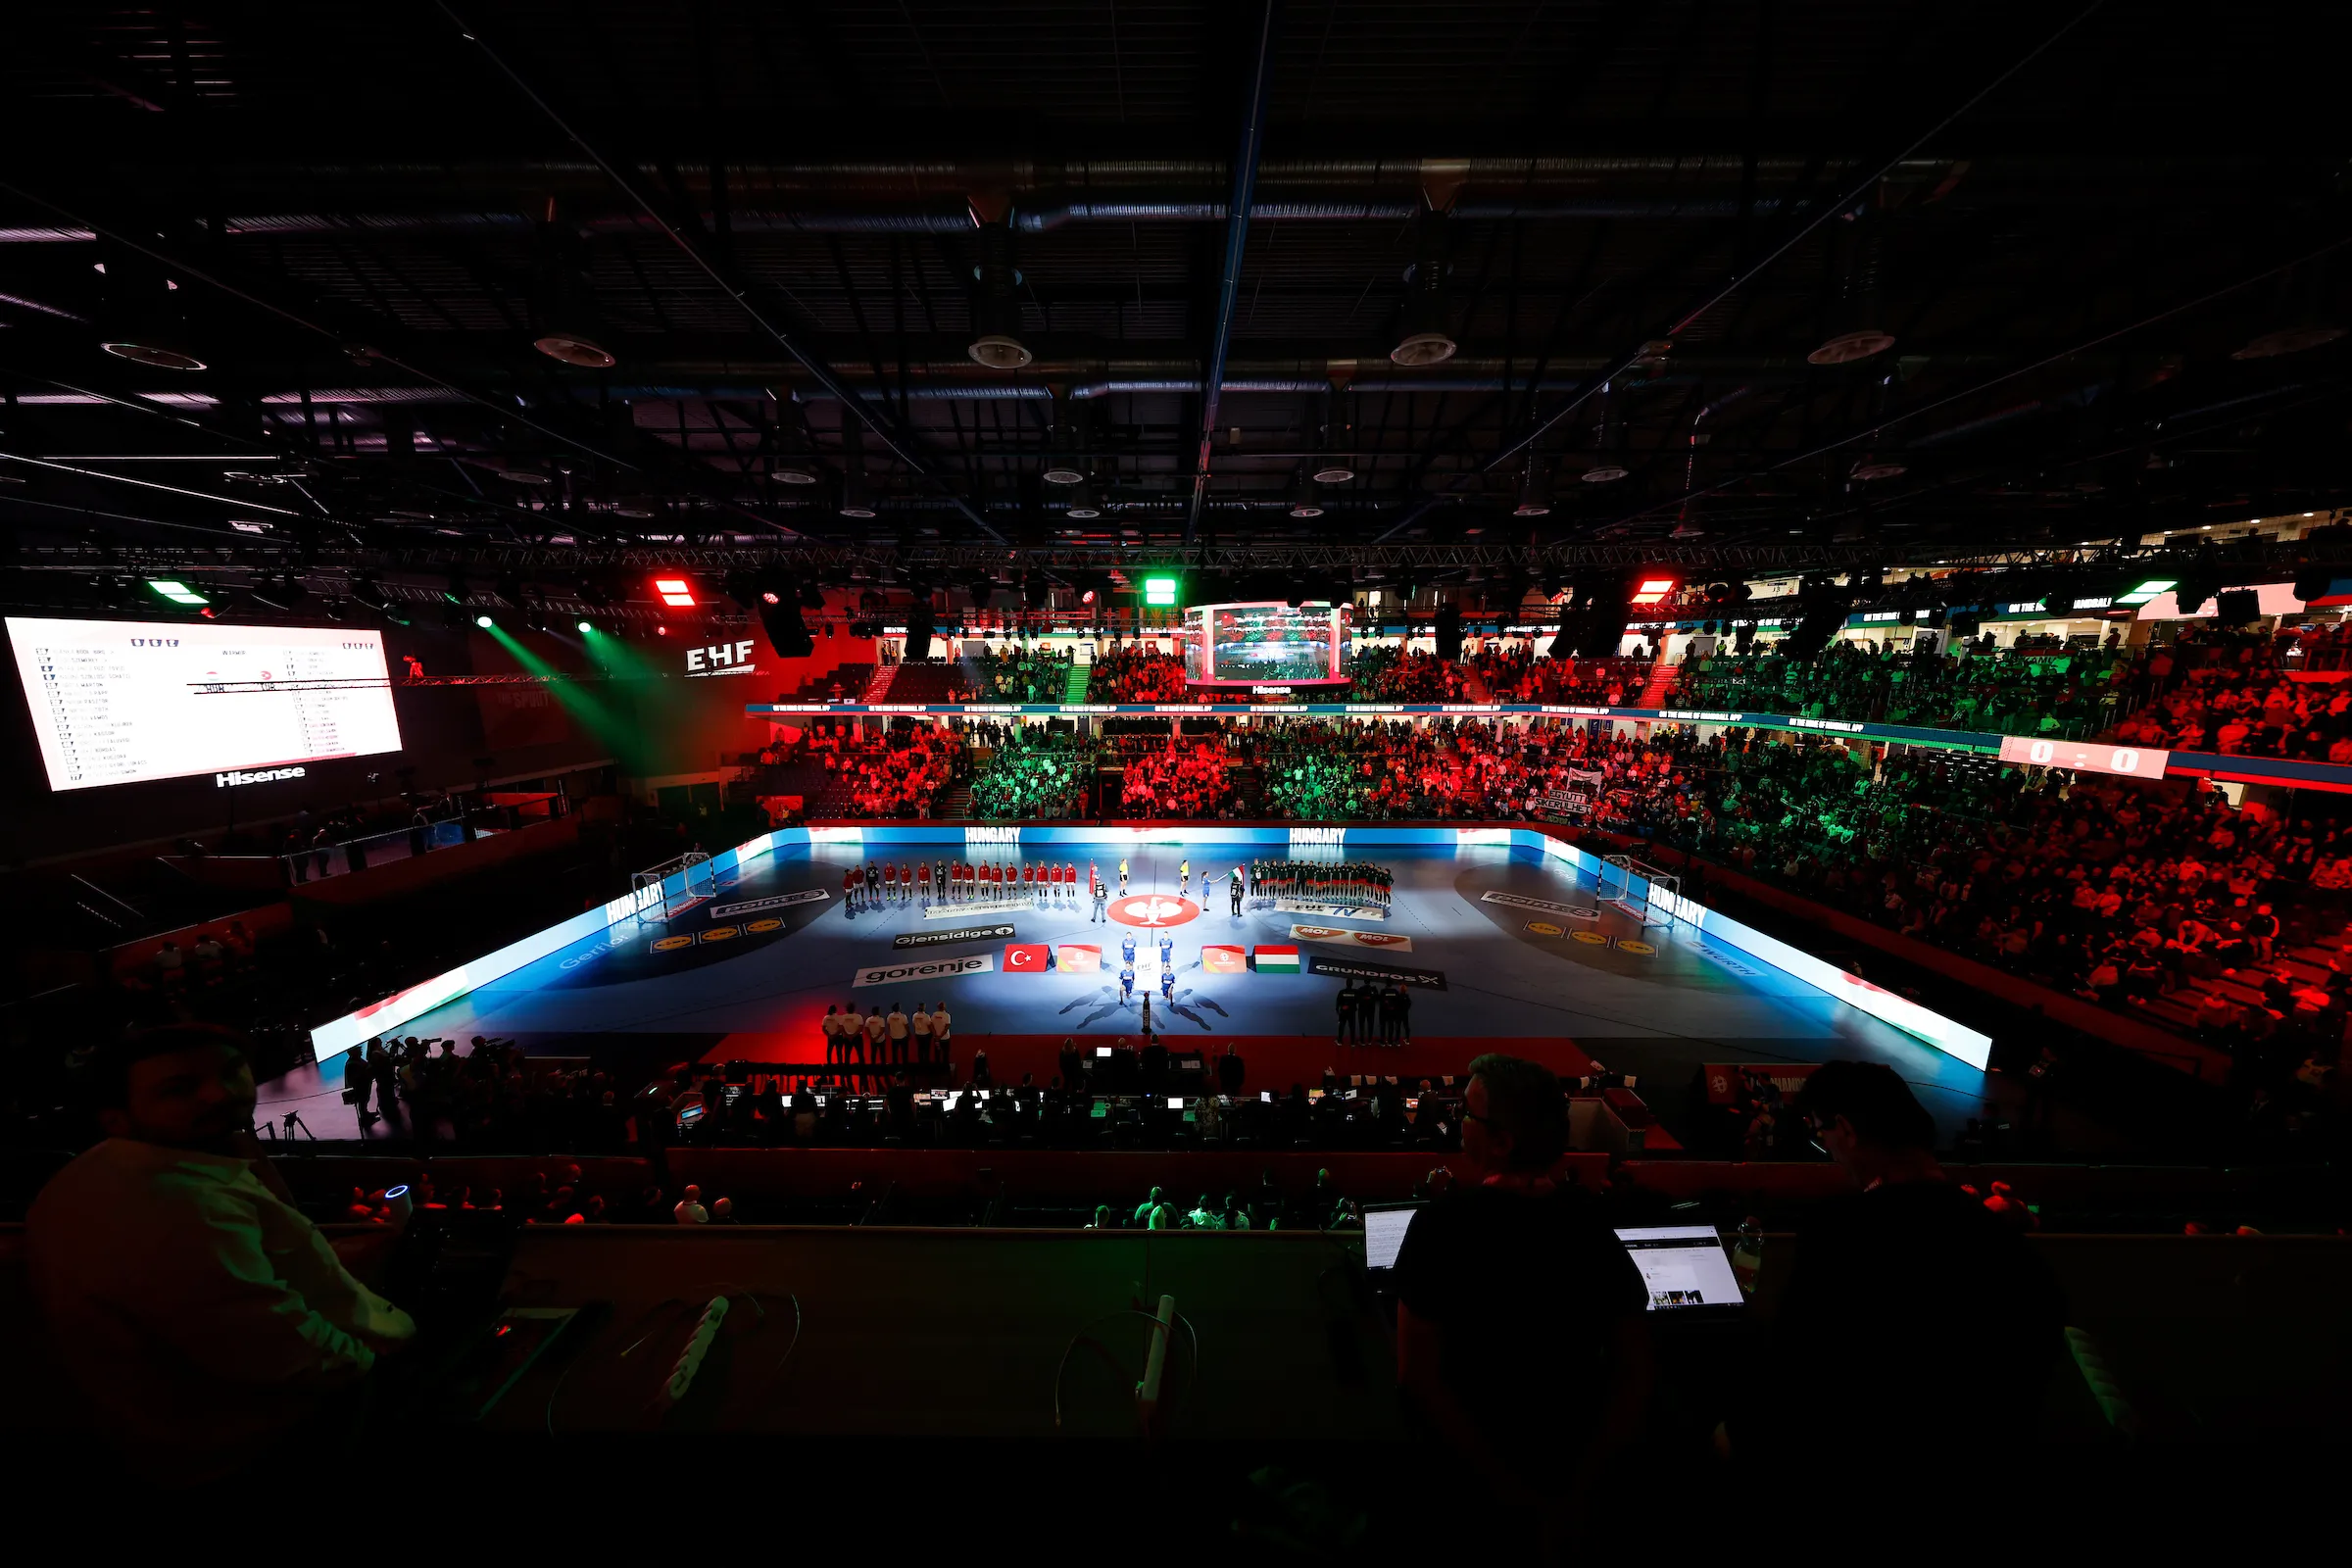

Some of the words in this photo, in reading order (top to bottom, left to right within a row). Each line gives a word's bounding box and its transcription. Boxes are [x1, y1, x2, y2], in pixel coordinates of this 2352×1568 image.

[686, 639, 755, 671] EHF
[2030, 741, 2054, 763] 0
[2110, 749, 2139, 772] 0
[216, 764, 306, 789] Hisense
[964, 827, 1021, 844] HUNGARY
[1288, 827, 1347, 845] HUNGARY
[1329, 906, 1363, 917] TV
[1648, 882, 1707, 928] HUNGARY
[895, 928, 994, 946] Gjensidige
[1359, 933, 1391, 942] MOL
[560, 934, 629, 969] Gerflor
[865, 958, 984, 984] gorenje
[1315, 964, 1417, 982] GRUNDFOS
